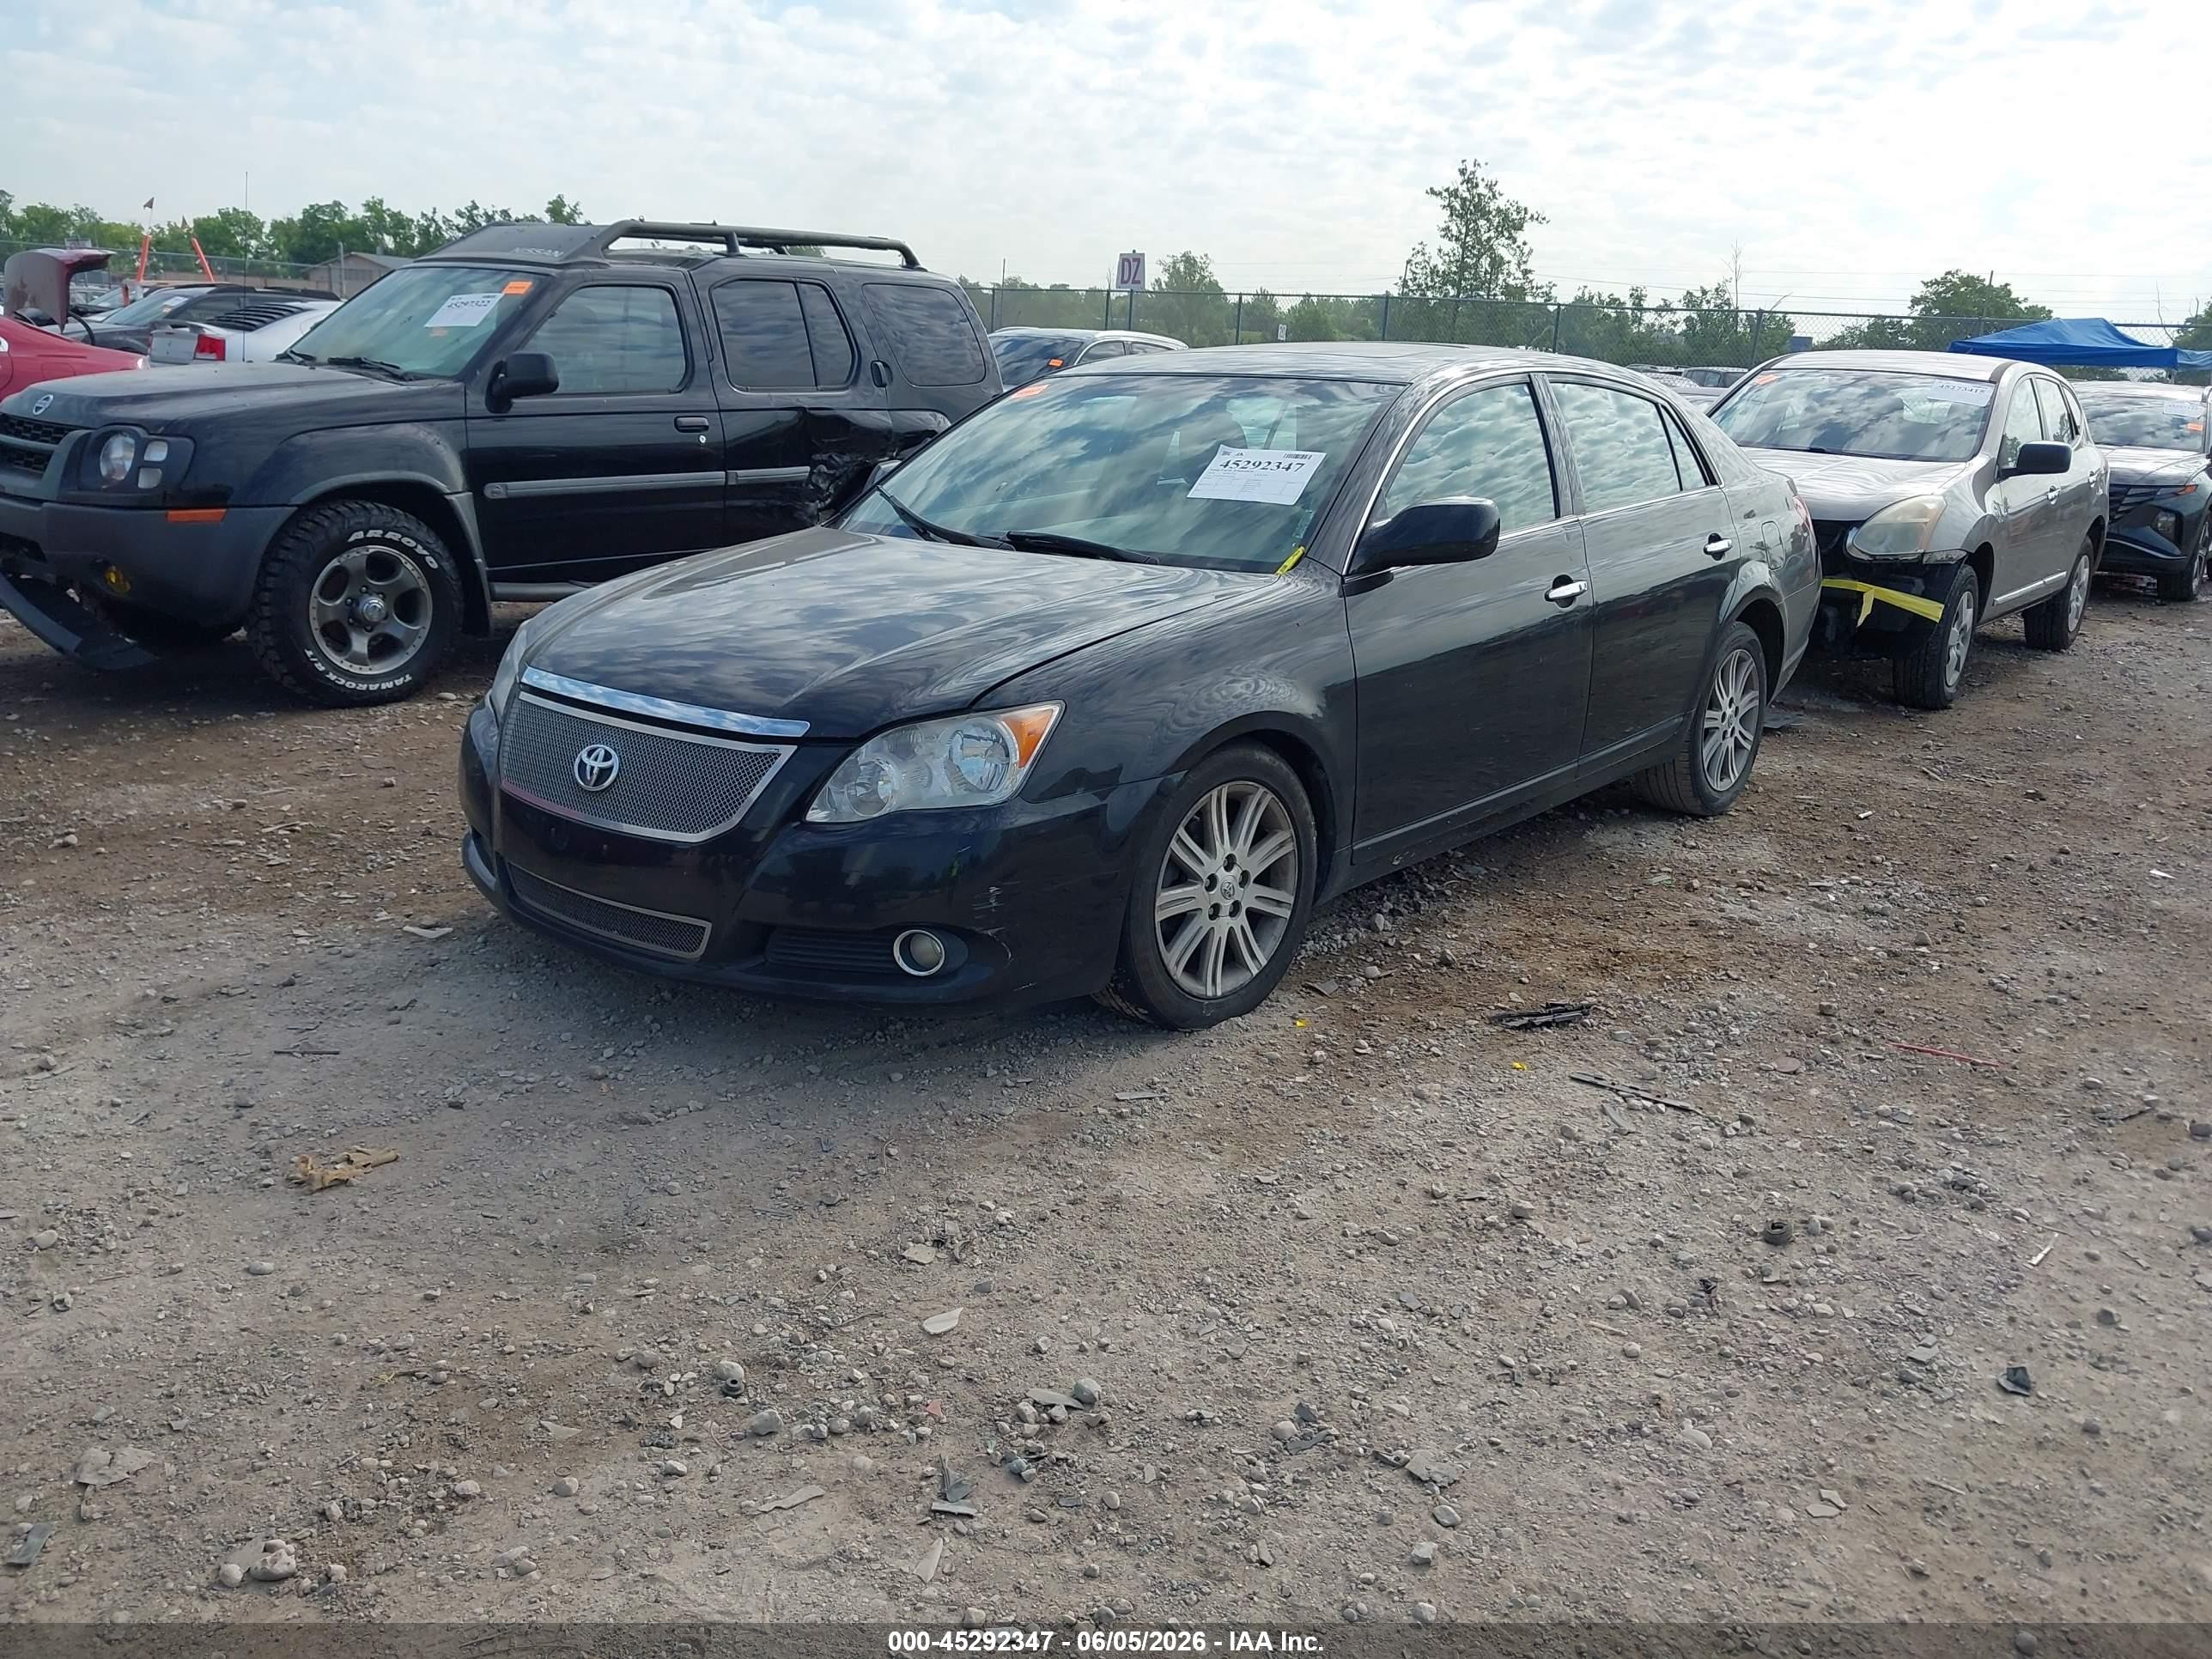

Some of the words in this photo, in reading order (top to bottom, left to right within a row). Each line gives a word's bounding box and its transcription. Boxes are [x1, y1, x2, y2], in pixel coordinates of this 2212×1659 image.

[1120, 257, 1141, 285] DZ
[1219, 459, 1306, 472] 45292347
[347, 529, 439, 569] ARROYO
[303, 648, 326, 672] R/T
[325, 672, 413, 691] TAMAROCK
